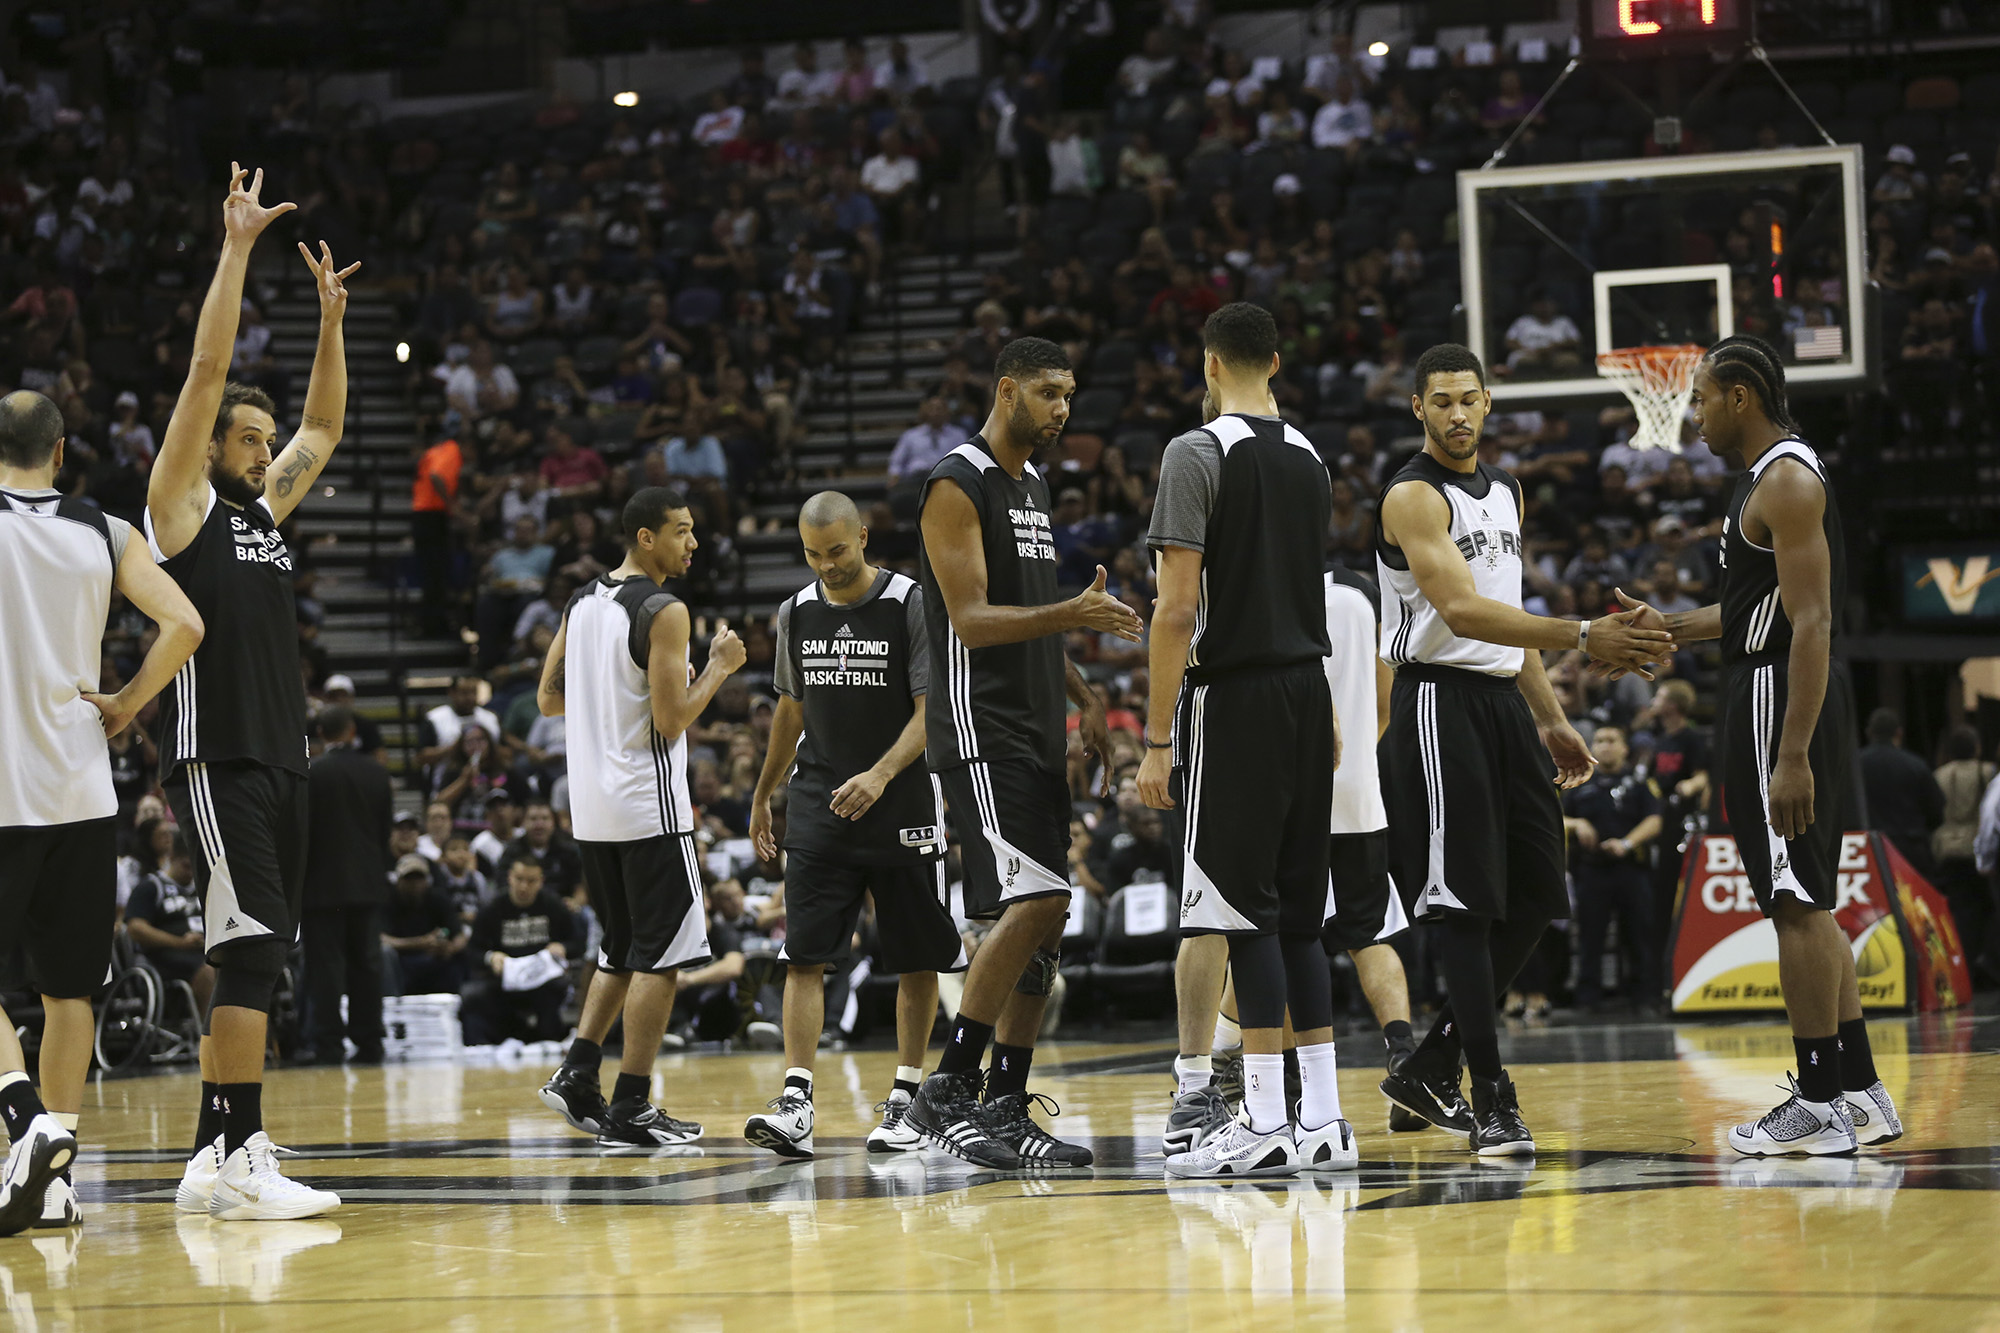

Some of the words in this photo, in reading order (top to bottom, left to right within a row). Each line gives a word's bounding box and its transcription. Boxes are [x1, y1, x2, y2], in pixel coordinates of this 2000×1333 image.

[801, 639, 828, 655] SAN
[830, 639, 889, 656] ANTONIO
[803, 670, 888, 687] BASKETBALL
[1743, 983, 1784, 999] Brak
